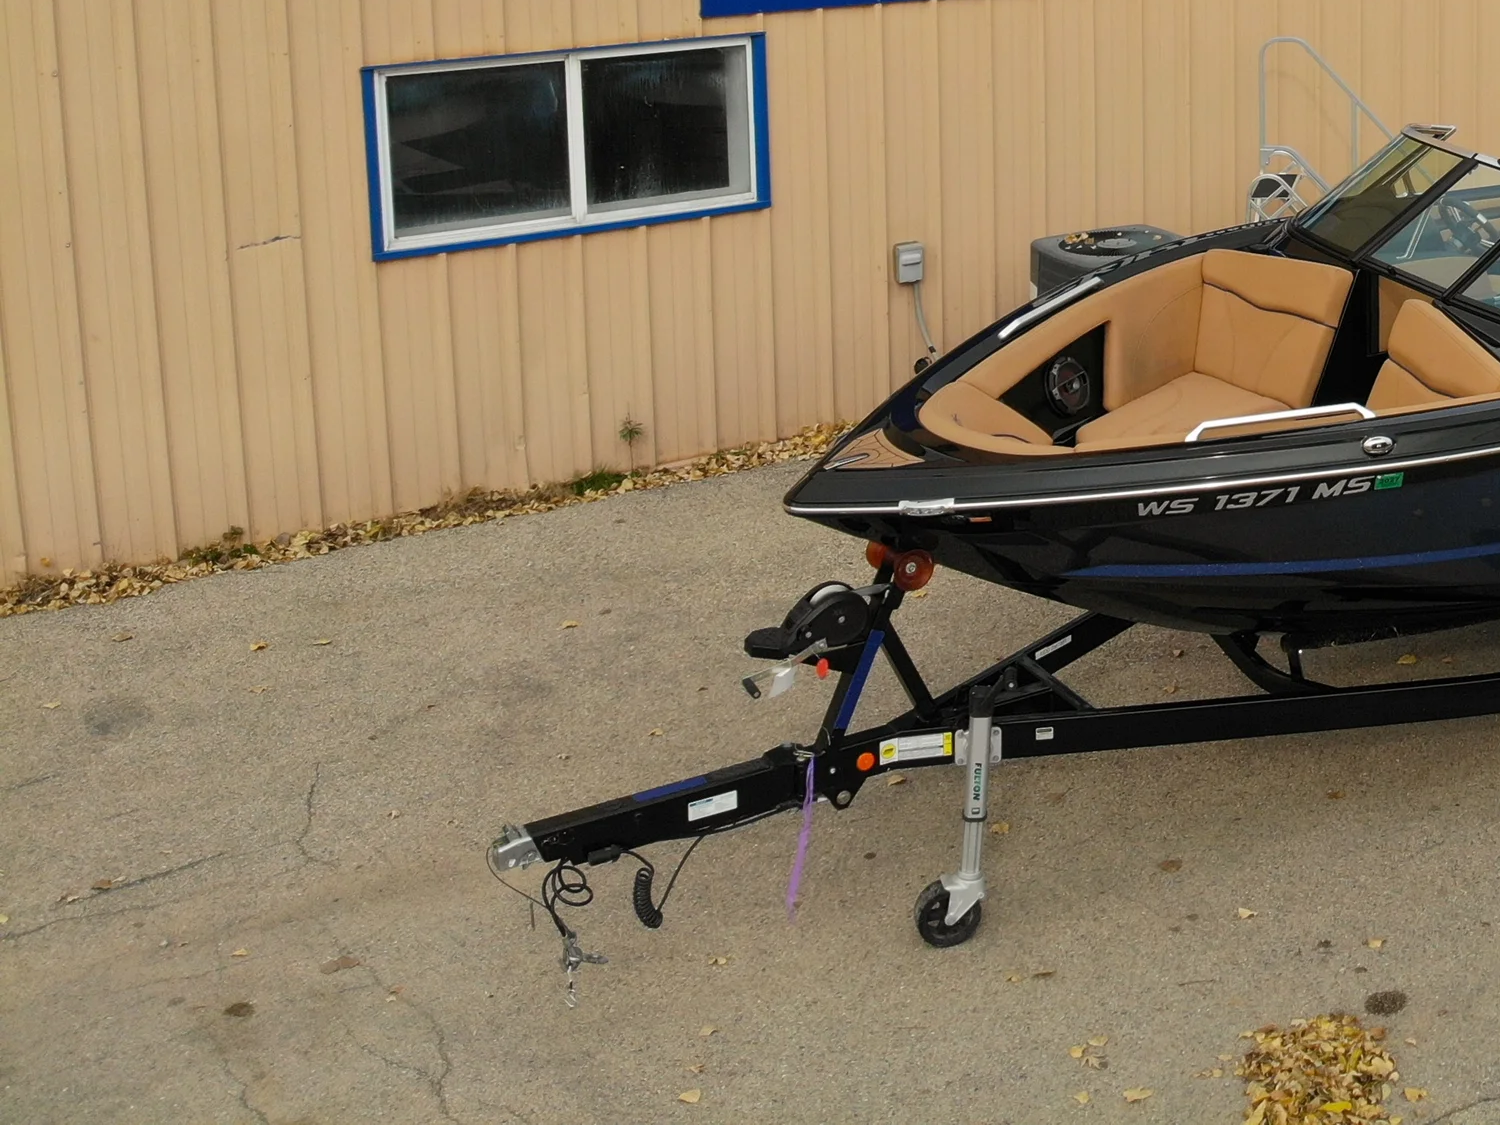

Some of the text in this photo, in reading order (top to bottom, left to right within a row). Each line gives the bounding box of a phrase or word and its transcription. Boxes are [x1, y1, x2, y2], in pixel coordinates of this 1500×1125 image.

[1137, 476, 1375, 517] WS 1371 MS
[972, 762, 982, 801] FULTON
